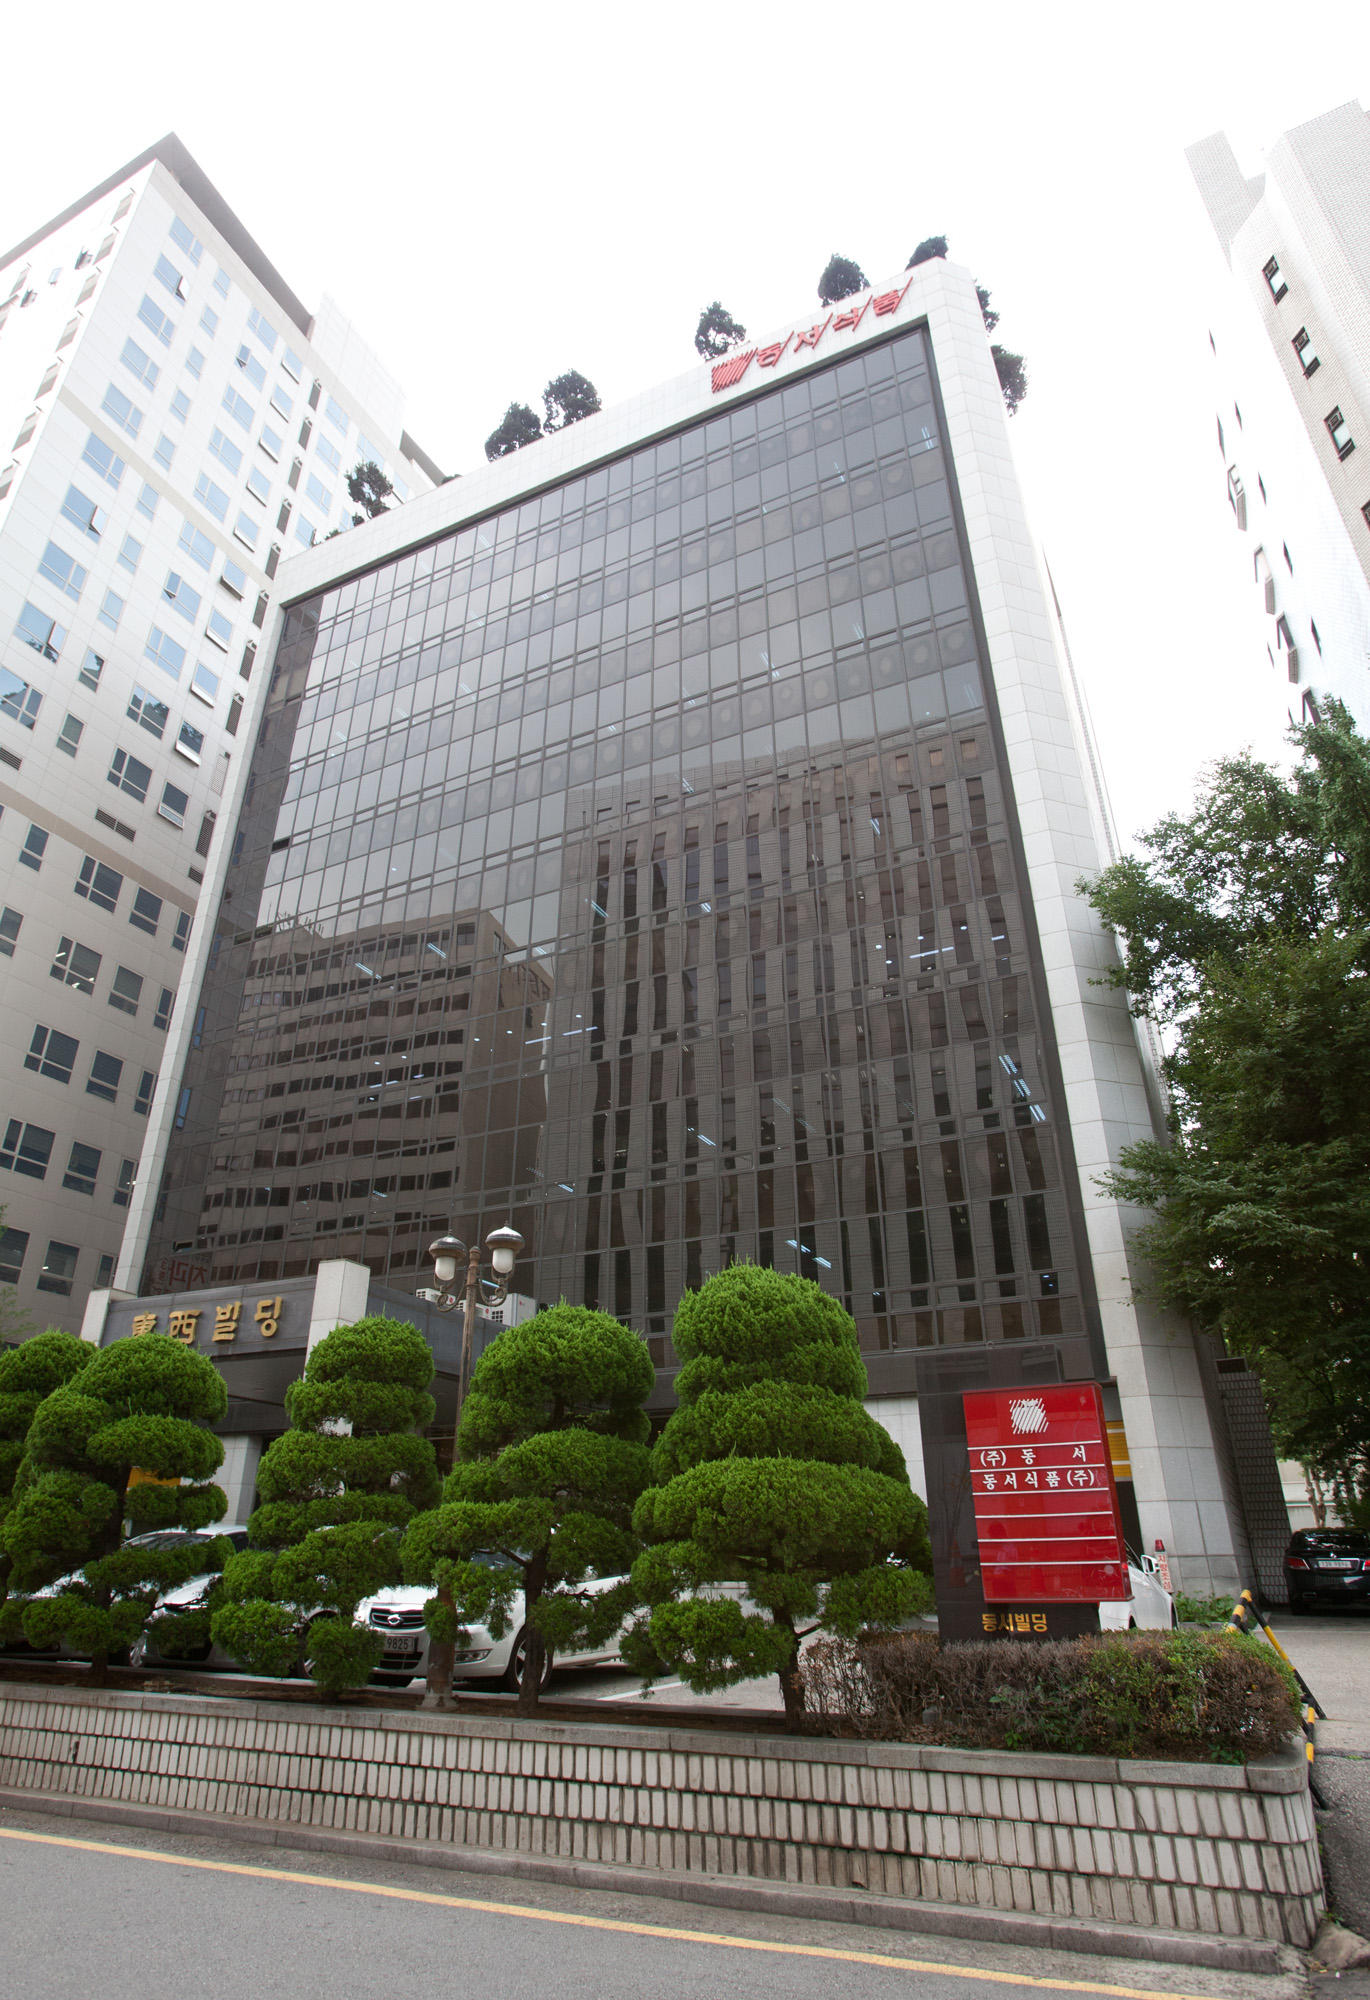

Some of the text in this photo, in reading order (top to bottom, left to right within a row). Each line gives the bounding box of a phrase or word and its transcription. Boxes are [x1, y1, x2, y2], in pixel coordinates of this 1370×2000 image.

[757, 276, 913, 367] 동서식품
[980, 1449, 1007, 1467] (주)
[1157, 1555, 1171, 1590] 차량조심
[982, 1613, 1048, 1633] 동서빌딩
[387, 1638, 409, 1650] 9825
